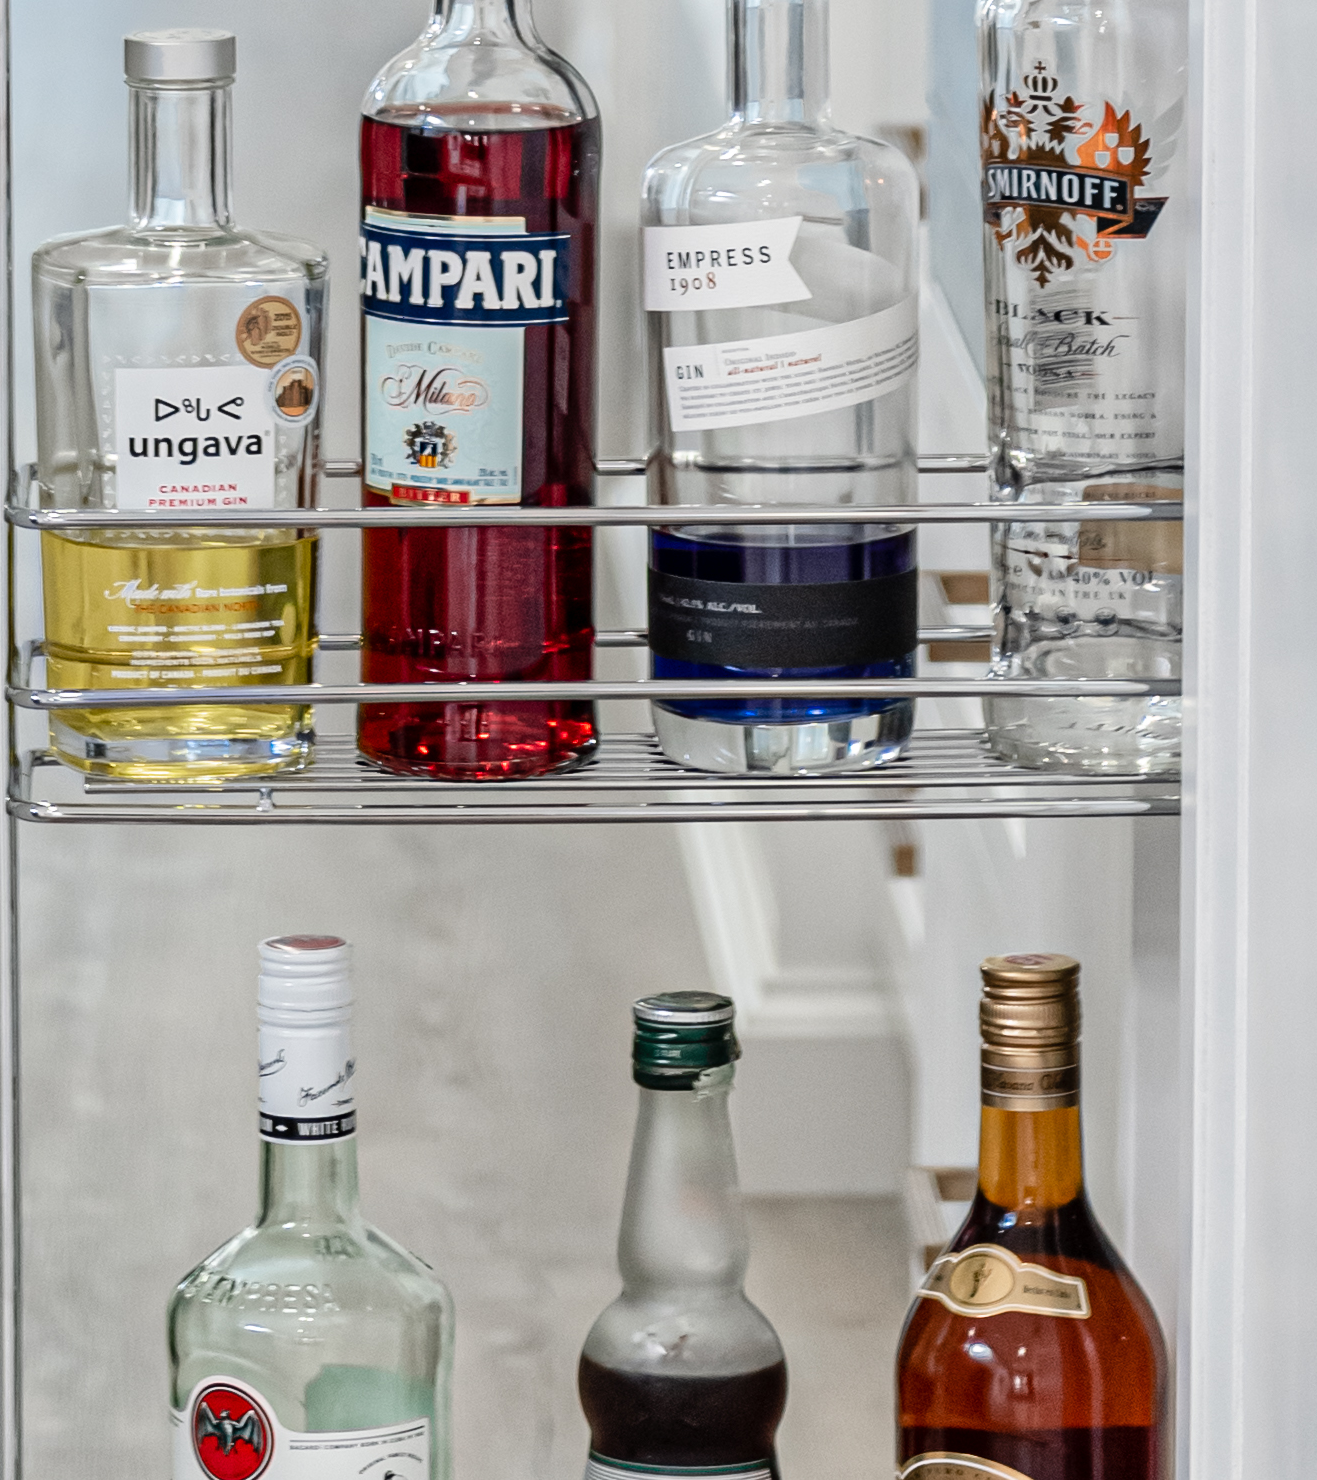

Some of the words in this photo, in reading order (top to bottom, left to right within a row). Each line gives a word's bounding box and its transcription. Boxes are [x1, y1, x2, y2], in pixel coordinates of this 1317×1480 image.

[987, 168, 1121, 209] SMIRNOFF
[666, 245, 773, 270] EMPRESS
[669, 271, 718, 296] 1908
[994, 298, 1113, 327] BLACK
[1053, 332, 1131, 358] Batch
[676, 364, 705, 379] GIN
[382, 364, 488, 416] Milano
[128, 432, 264, 466] ungava
[158, 483, 238, 494] CANADIAN
[148, 497, 218, 508] PREMIUM
[222, 496, 248, 506] GIN
[1073, 590, 1101, 600] THE
[686, 628, 713, 643] GIN
